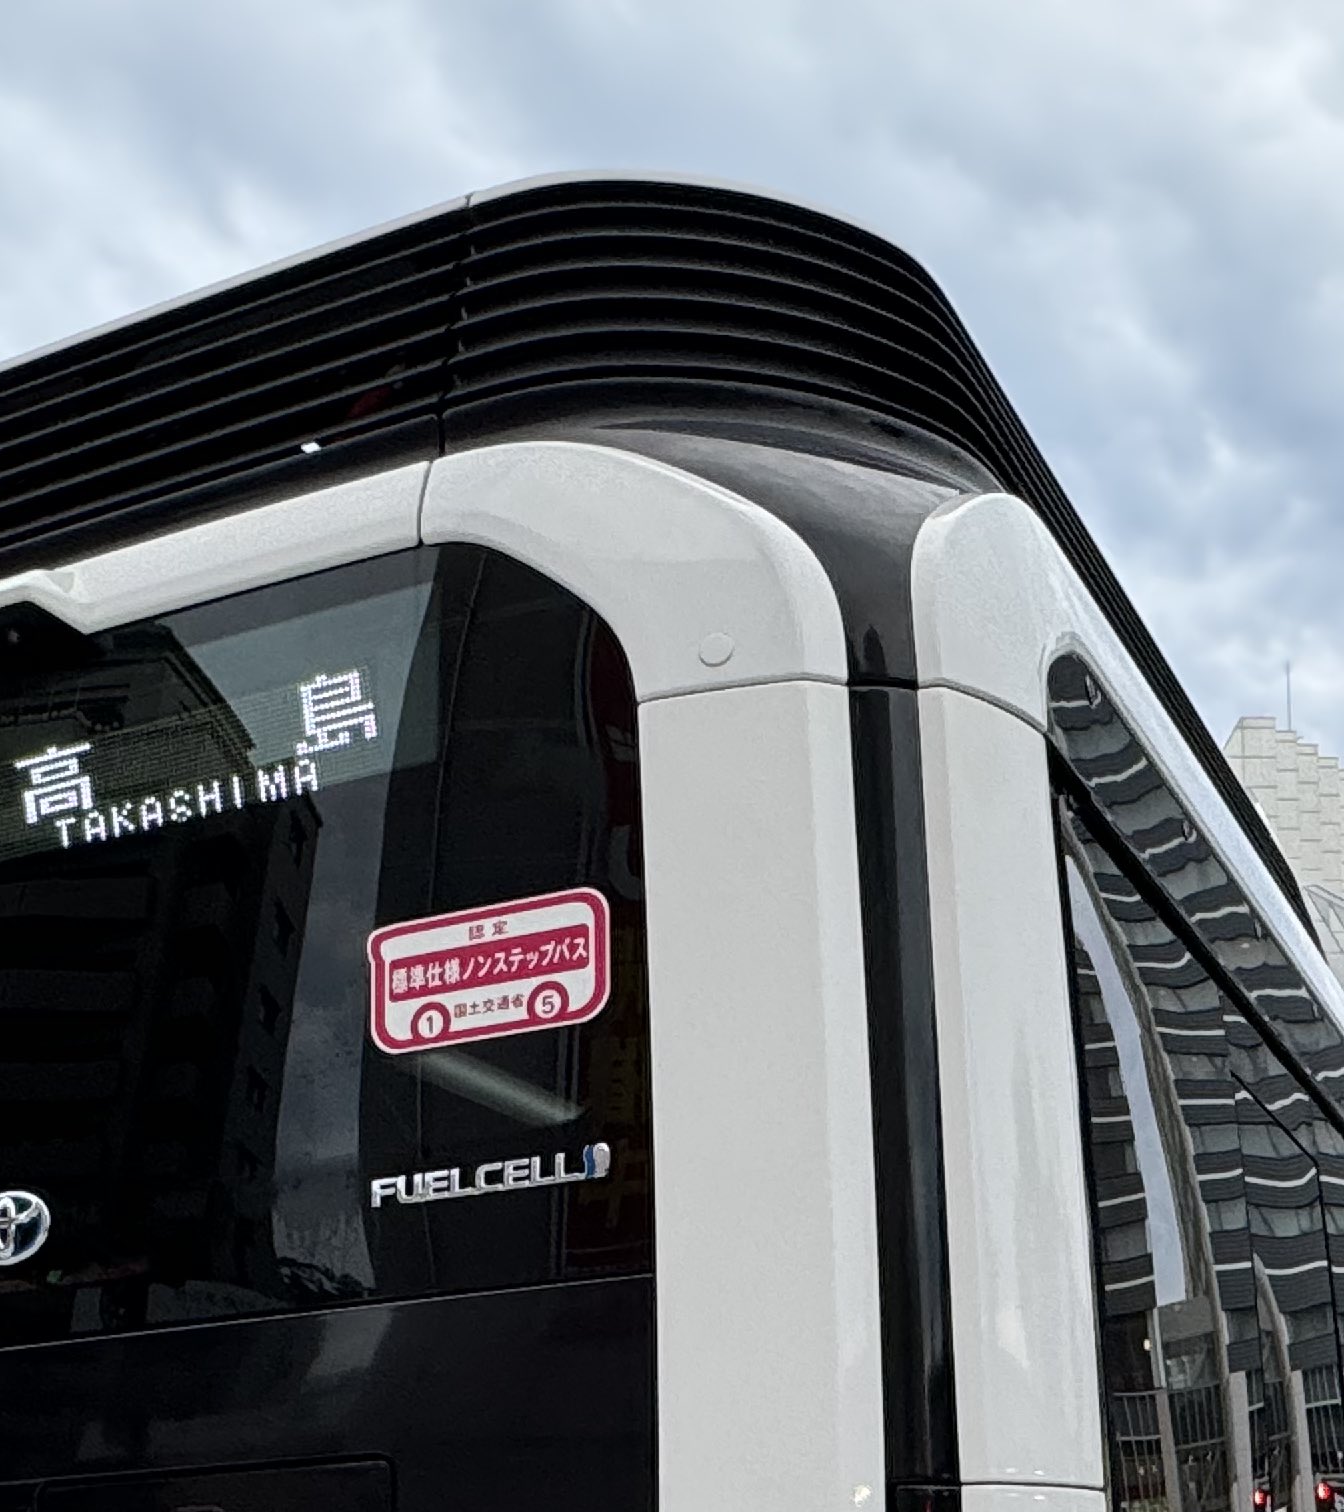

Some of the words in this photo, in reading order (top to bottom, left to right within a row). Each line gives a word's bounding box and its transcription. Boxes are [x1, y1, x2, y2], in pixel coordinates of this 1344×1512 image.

[55, 757, 320, 848] TAKASHIMA
[391, 937, 588, 995] 標準仕様ノンステップバス
